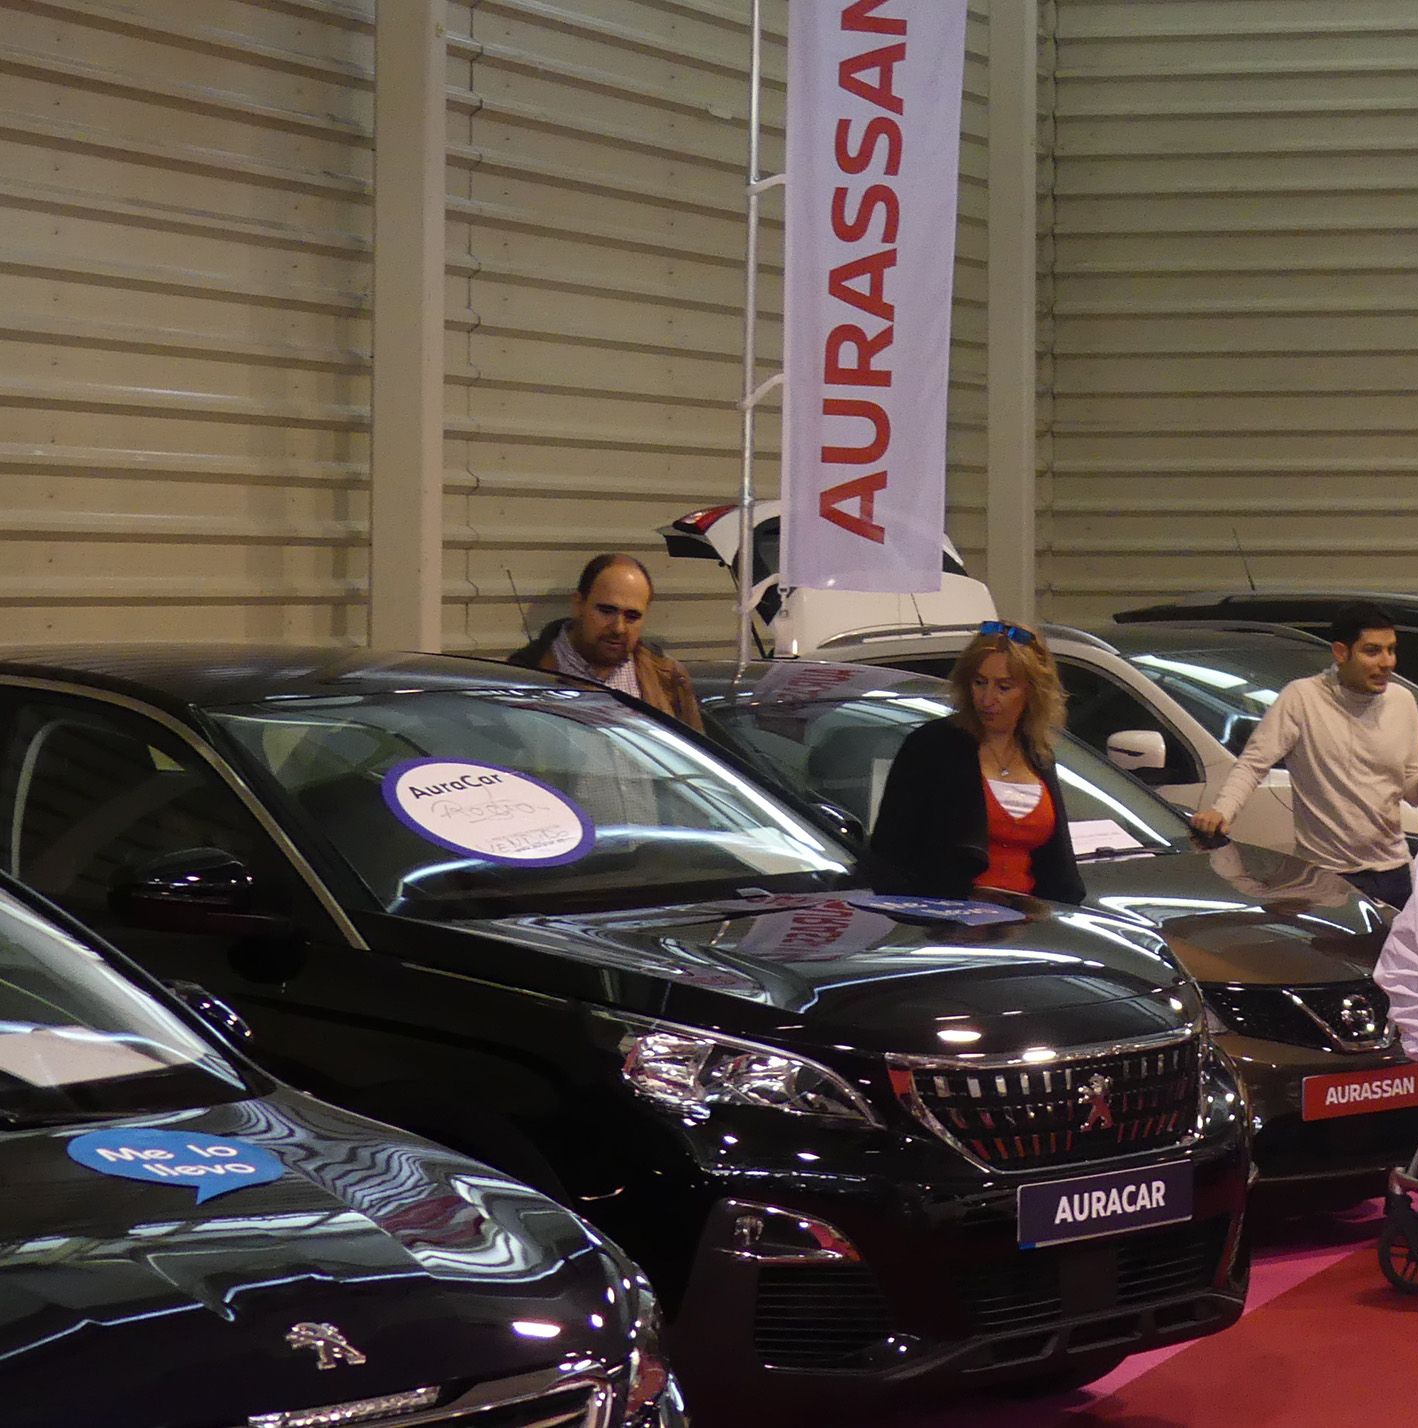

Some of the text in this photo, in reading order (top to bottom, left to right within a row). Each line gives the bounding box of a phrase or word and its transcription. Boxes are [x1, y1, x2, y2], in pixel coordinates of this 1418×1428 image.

[408, 773, 503, 799] AuraCar
[1325, 1076, 1415, 1105] AURASSAN
[96, 1144, 238, 1162] Me lo
[142, 1163, 256, 1177] llevo
[1054, 1180, 1166, 1225] AURACAR
